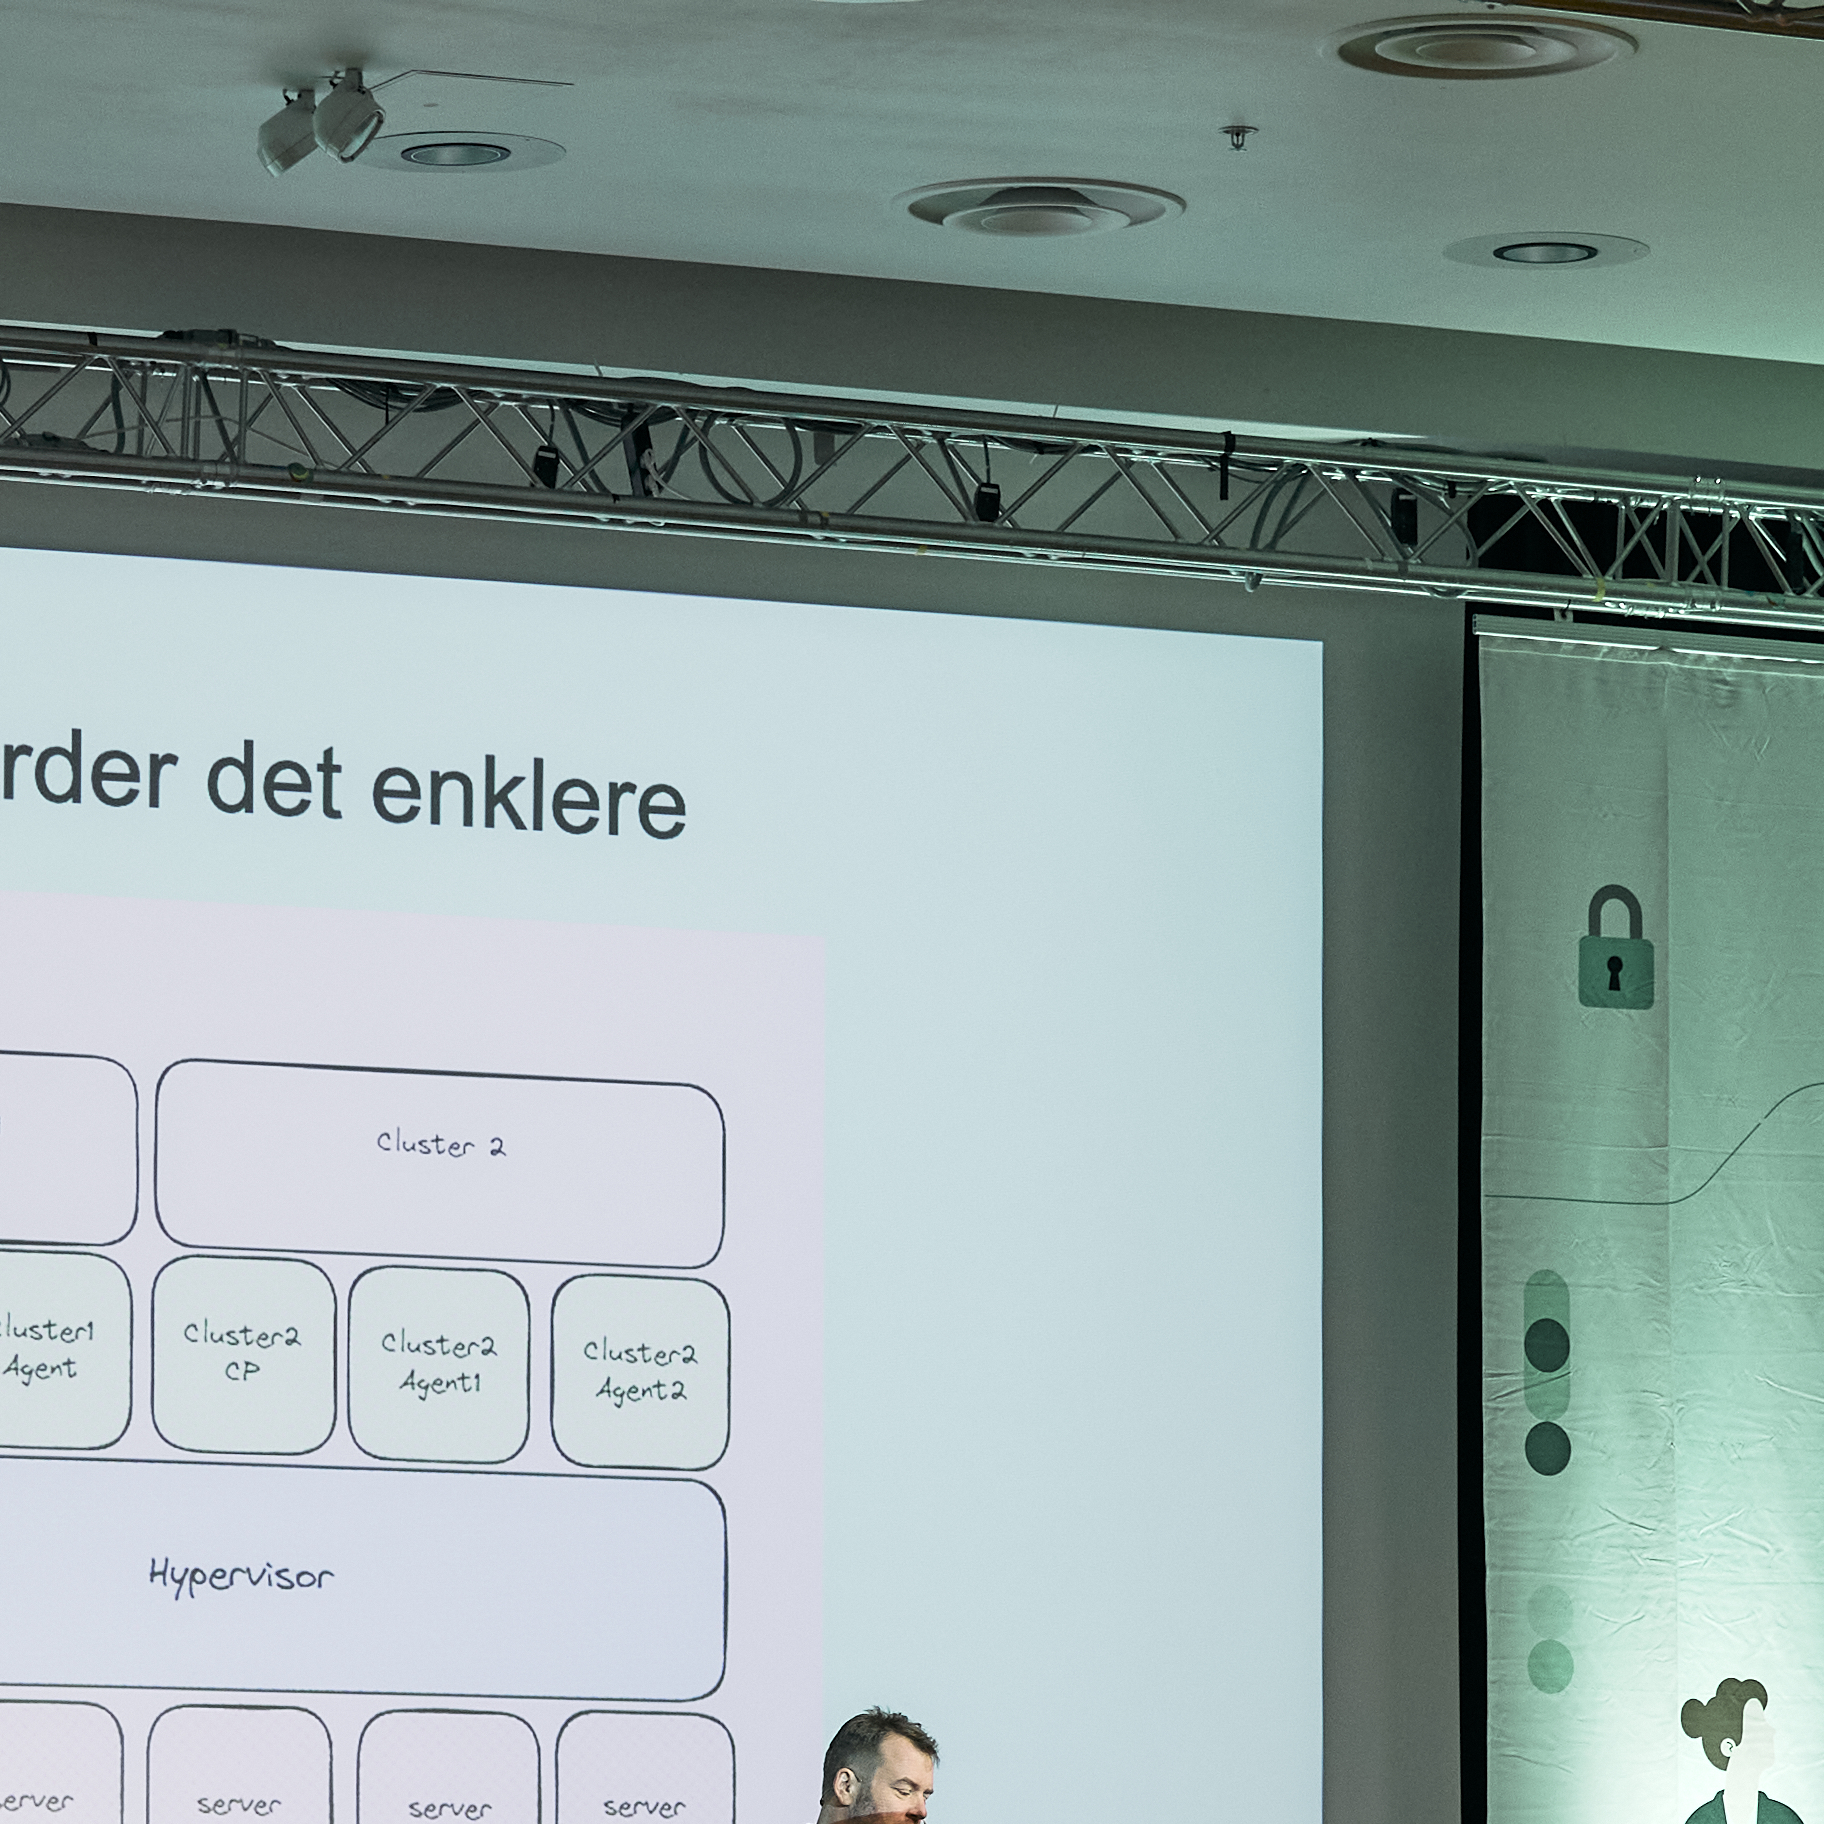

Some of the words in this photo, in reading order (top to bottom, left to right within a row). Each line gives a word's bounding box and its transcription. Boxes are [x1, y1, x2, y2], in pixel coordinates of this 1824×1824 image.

[206, 737, 344, 821] det
[371, 752, 688, 841] enklere
[376, 1125, 476, 1159] Cluster
[489, 1135, 508, 1158] 2
[182, 1317, 303, 1351] Cluster2
[380, 1326, 499, 1360] Cluster2
[582, 1335, 700, 1368] Cluster2
[1, 1352, 78, 1388] Agent
[224, 1359, 262, 1382] CP
[397, 1368, 481, 1403] Agent1
[594, 1375, 689, 1410] Agent2
[148, 1556, 336, 1603] Hypervisor
[195, 1796, 283, 1818] server
[407, 1800, 494, 1823] server
[602, 1799, 688, 1821] server
